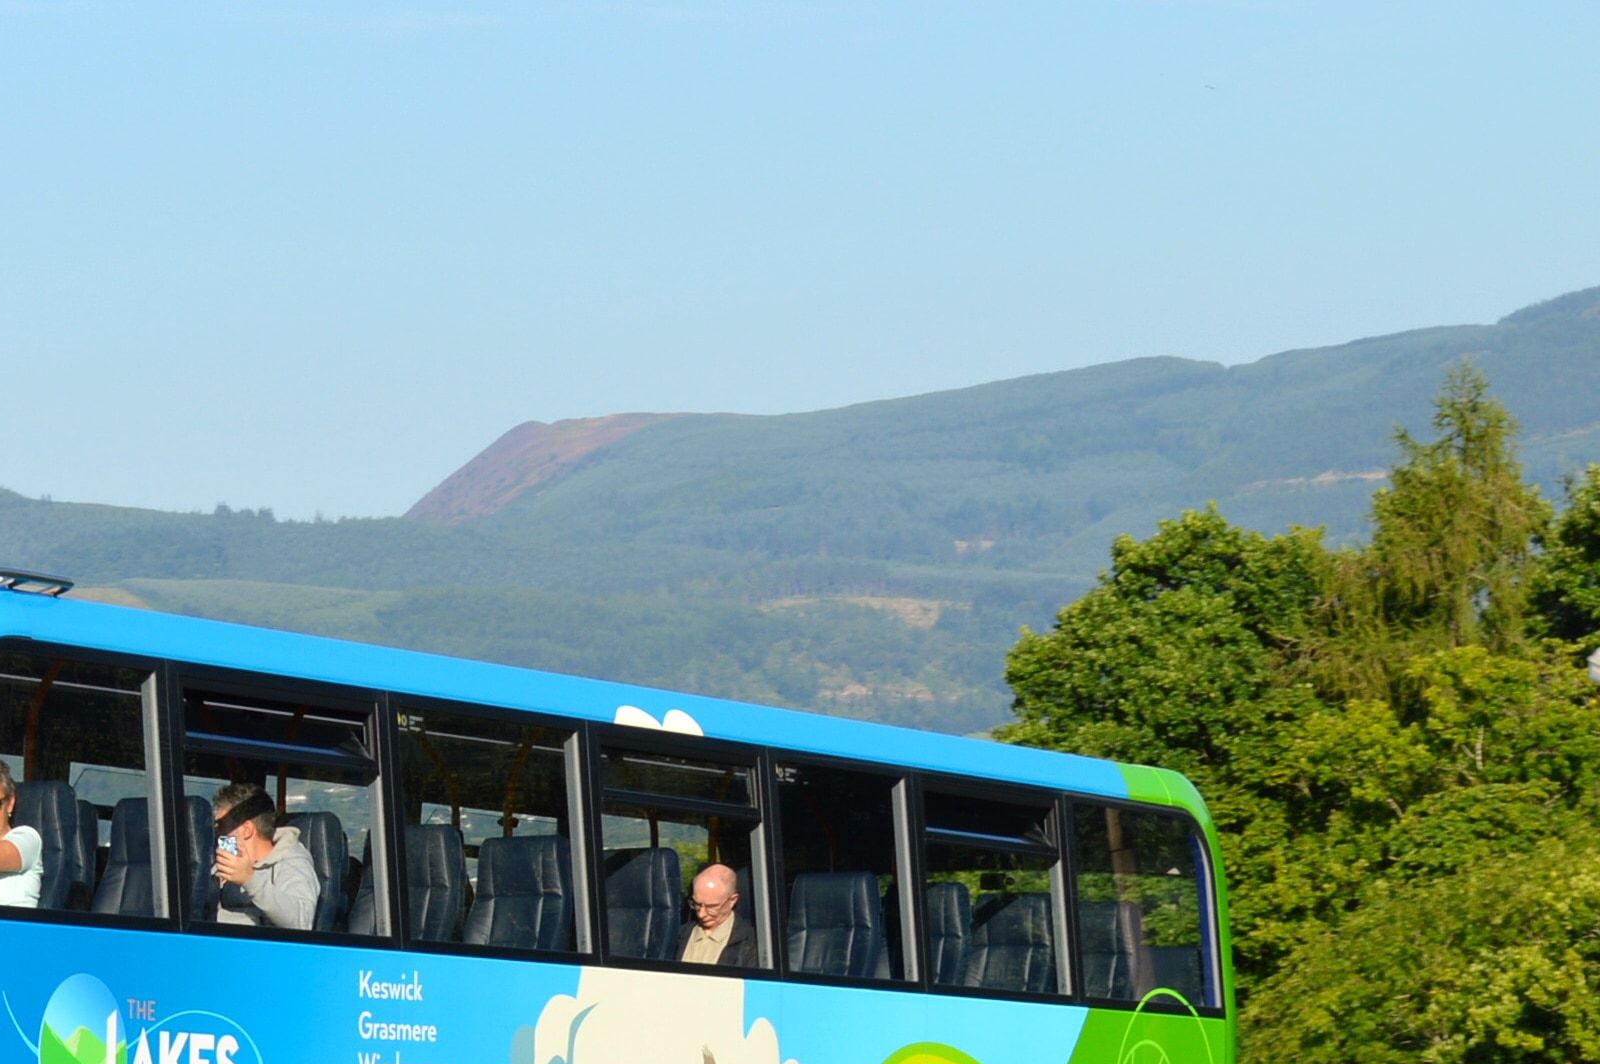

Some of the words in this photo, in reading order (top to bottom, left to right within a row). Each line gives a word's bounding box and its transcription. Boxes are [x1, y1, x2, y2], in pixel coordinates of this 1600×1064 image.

[358, 970, 424, 1001] Keswick
[127, 998, 156, 1021] THE
[357, 1011, 438, 1042] Grasmere
